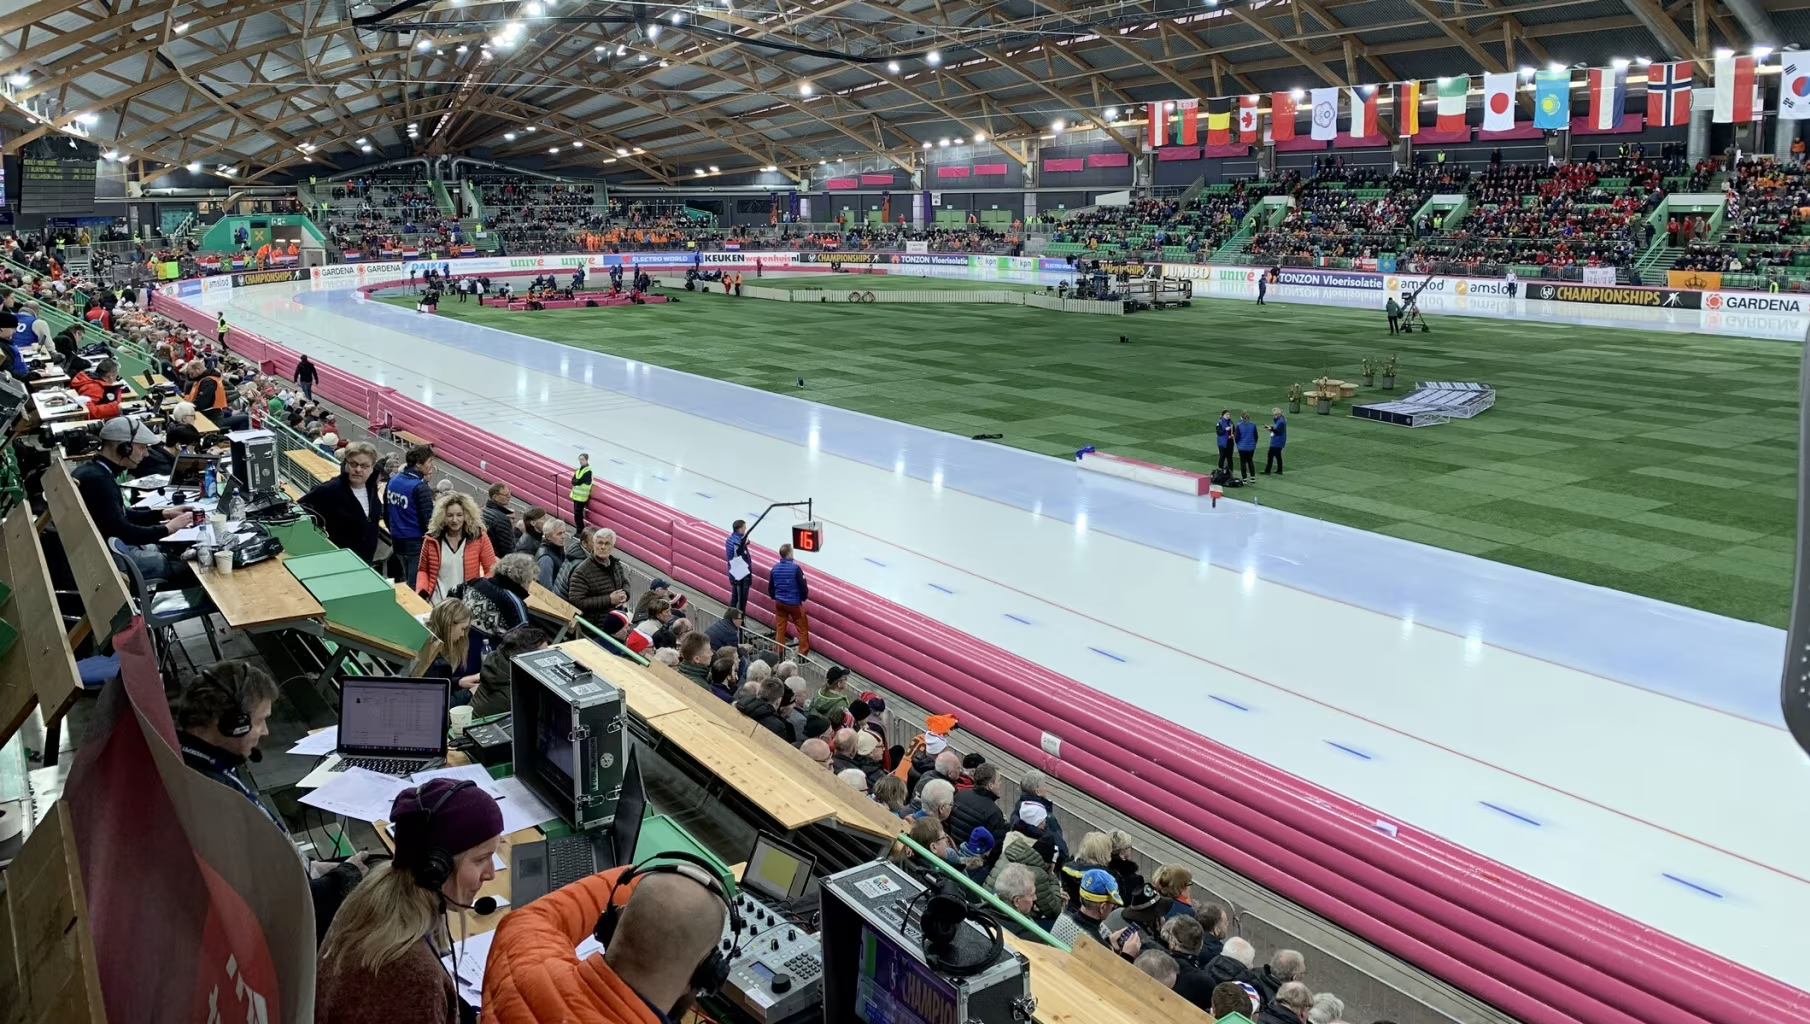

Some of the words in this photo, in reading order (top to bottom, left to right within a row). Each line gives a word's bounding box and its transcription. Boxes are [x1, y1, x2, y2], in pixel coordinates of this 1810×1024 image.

[818, 253, 870, 262] CHAMPIONSHIPS
[901, 255, 930, 264] TONZON
[932, 256, 968, 266] Vloerisolatie
[1019, 259, 1032, 268] kpn
[322, 267, 354, 277] GARDENA
[366, 264, 401, 274] GARDENA
[1165, 264, 1210, 280] JUMBO
[209, 277, 229, 288] amslod
[245, 270, 292, 284] CHAMPIONSHIPS
[1280, 272, 1320, 286] TONZON
[1323, 275, 1383, 289] Vloerisolatie
[1401, 278, 1445, 292] amslod
[1557, 286, 1661, 306] CHAMPIONSHIPS
[1727, 297, 1800, 312] GARDENA
[800, 530, 813, 550] 16
